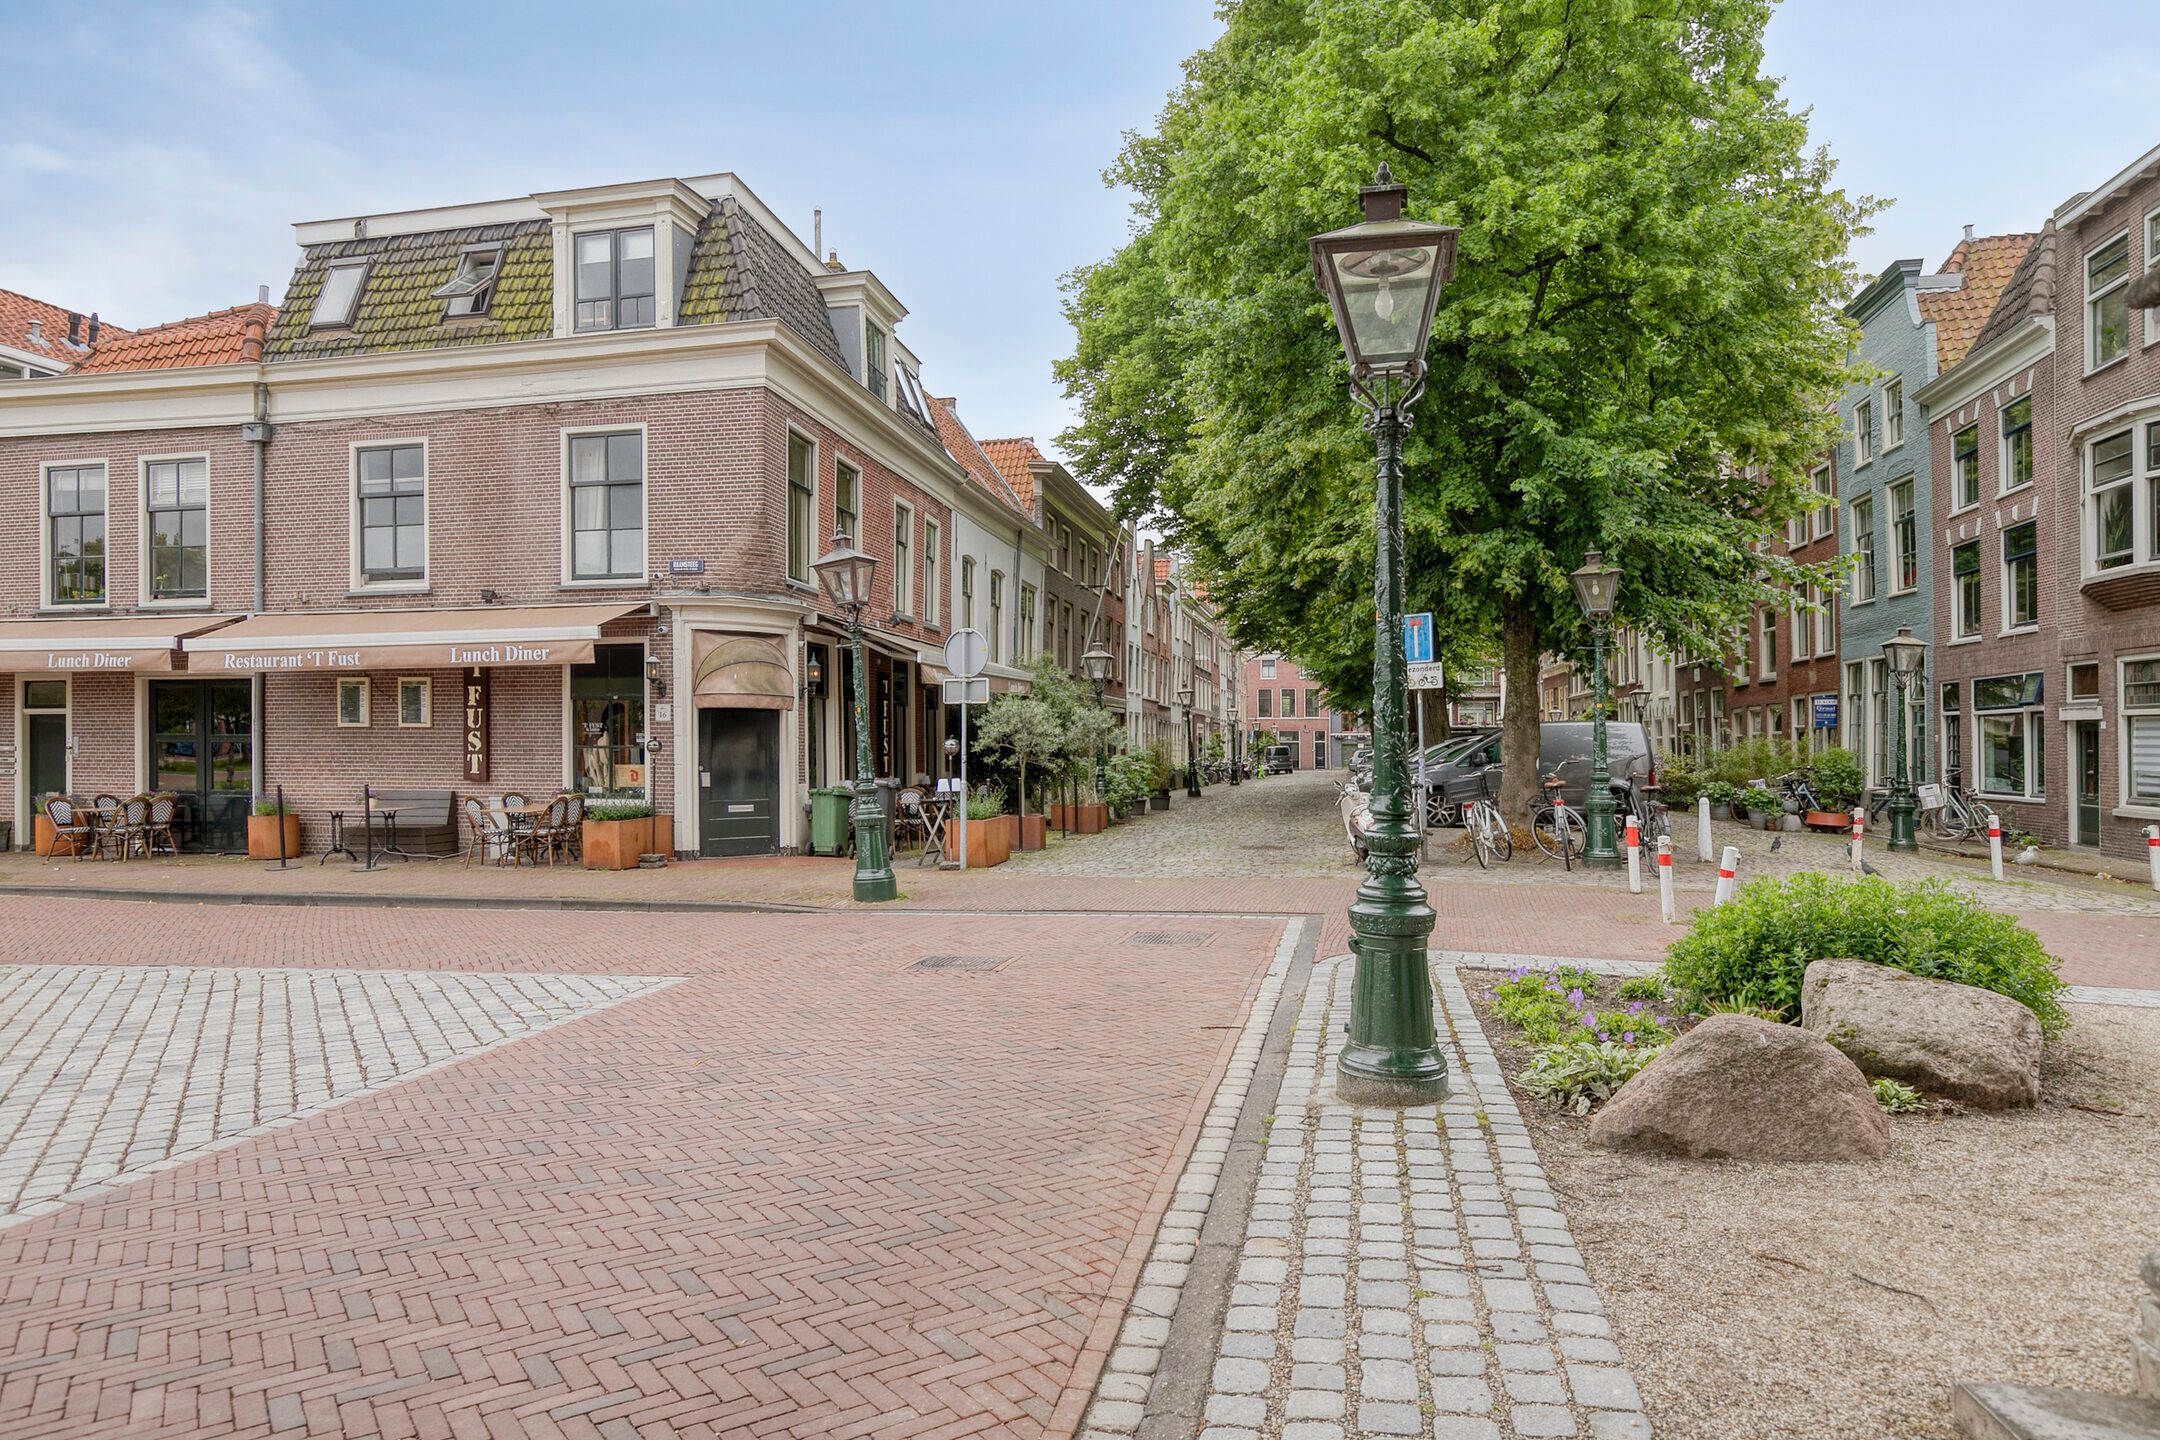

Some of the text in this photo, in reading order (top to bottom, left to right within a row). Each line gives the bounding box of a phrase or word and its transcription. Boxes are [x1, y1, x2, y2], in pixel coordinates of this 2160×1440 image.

[48, 653, 132, 668] Lunch Diner
[224, 653, 303, 668] Restaurant
[328, 650, 360, 666] Fust
[450, 645, 549, 663] Lunch Diner
[466, 685, 484, 774] FUST
